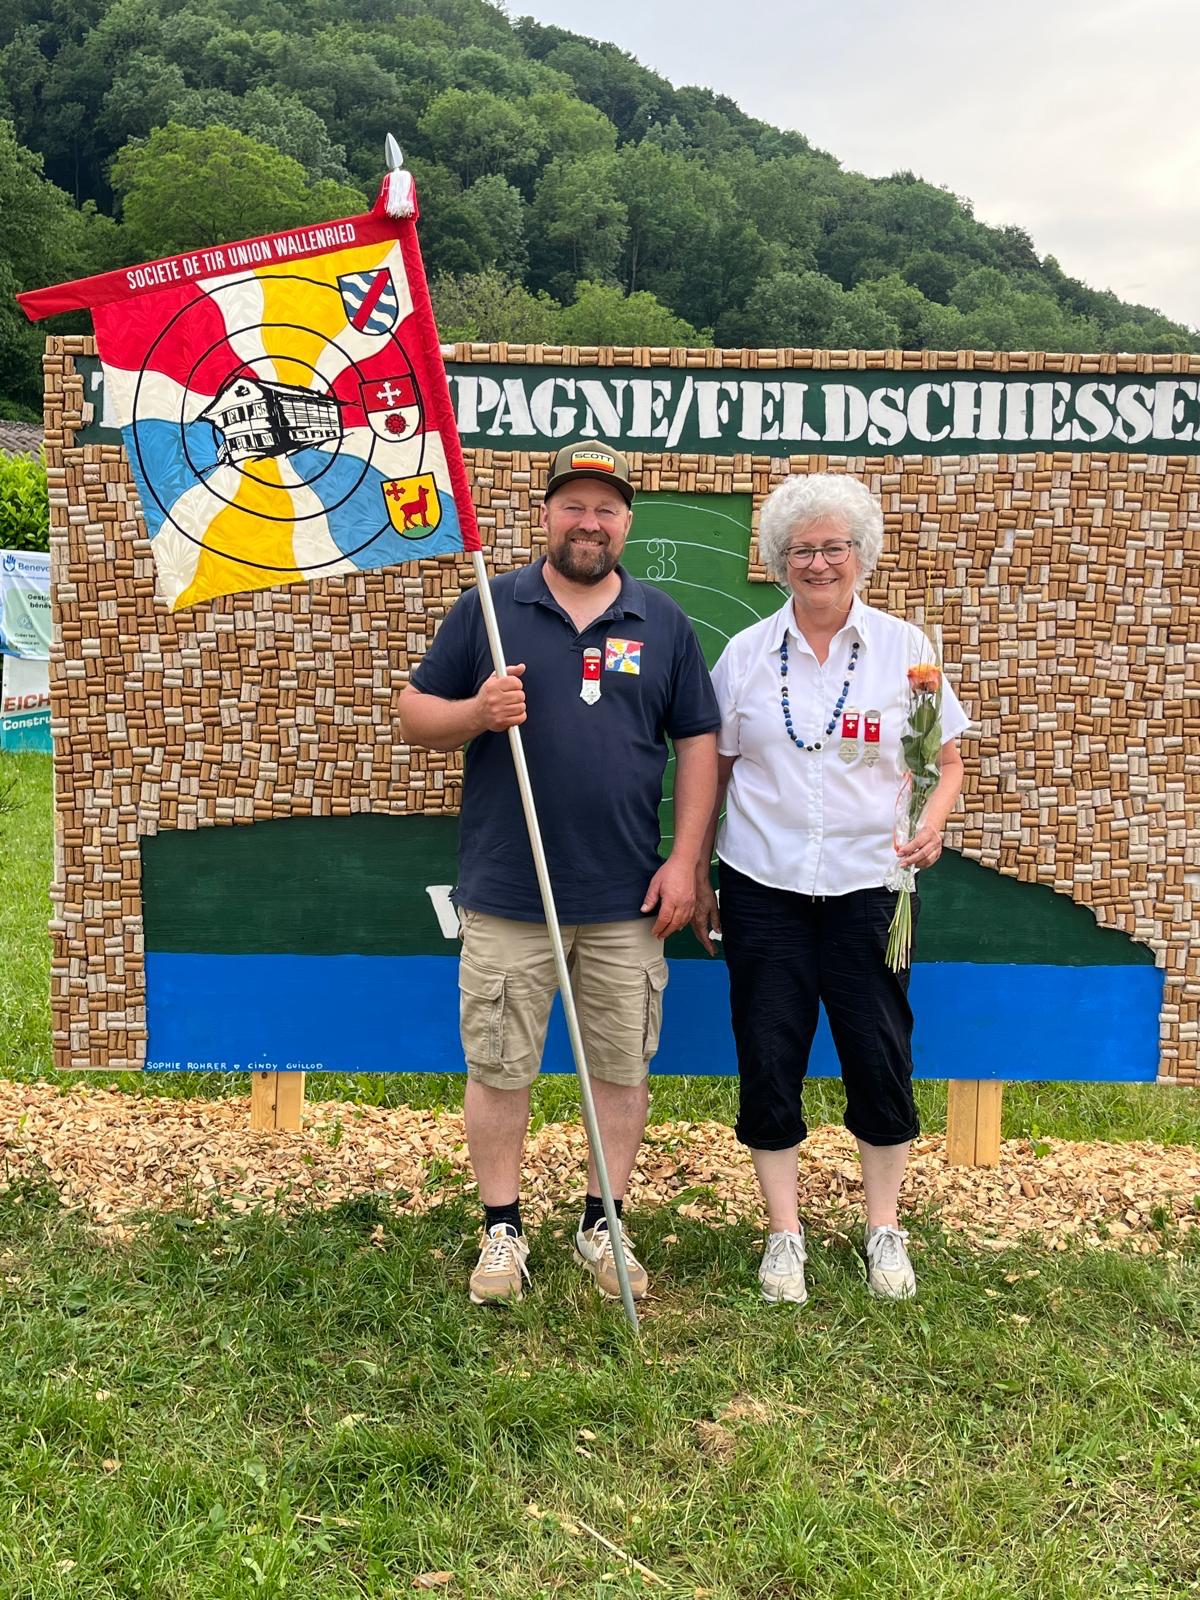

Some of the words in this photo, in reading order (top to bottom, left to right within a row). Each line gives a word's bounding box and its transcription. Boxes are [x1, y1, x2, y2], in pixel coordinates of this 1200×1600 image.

[126, 260, 181, 290] SOCIETE
[182, 255, 201, 276] DE
[201, 250, 226, 272] TIR
[228, 240, 272, 267] UNION
[273, 223, 356, 257] WALLENRIED
[446, 374, 1200, 447] PAGNE/FELDSCHIESSE
[574, 453, 612, 462] SCOTT
[646, 537, 678, 582] 3
[146, 1061, 181, 1070] SOPHIE
[187, 1061, 227, 1070] ROHRER
